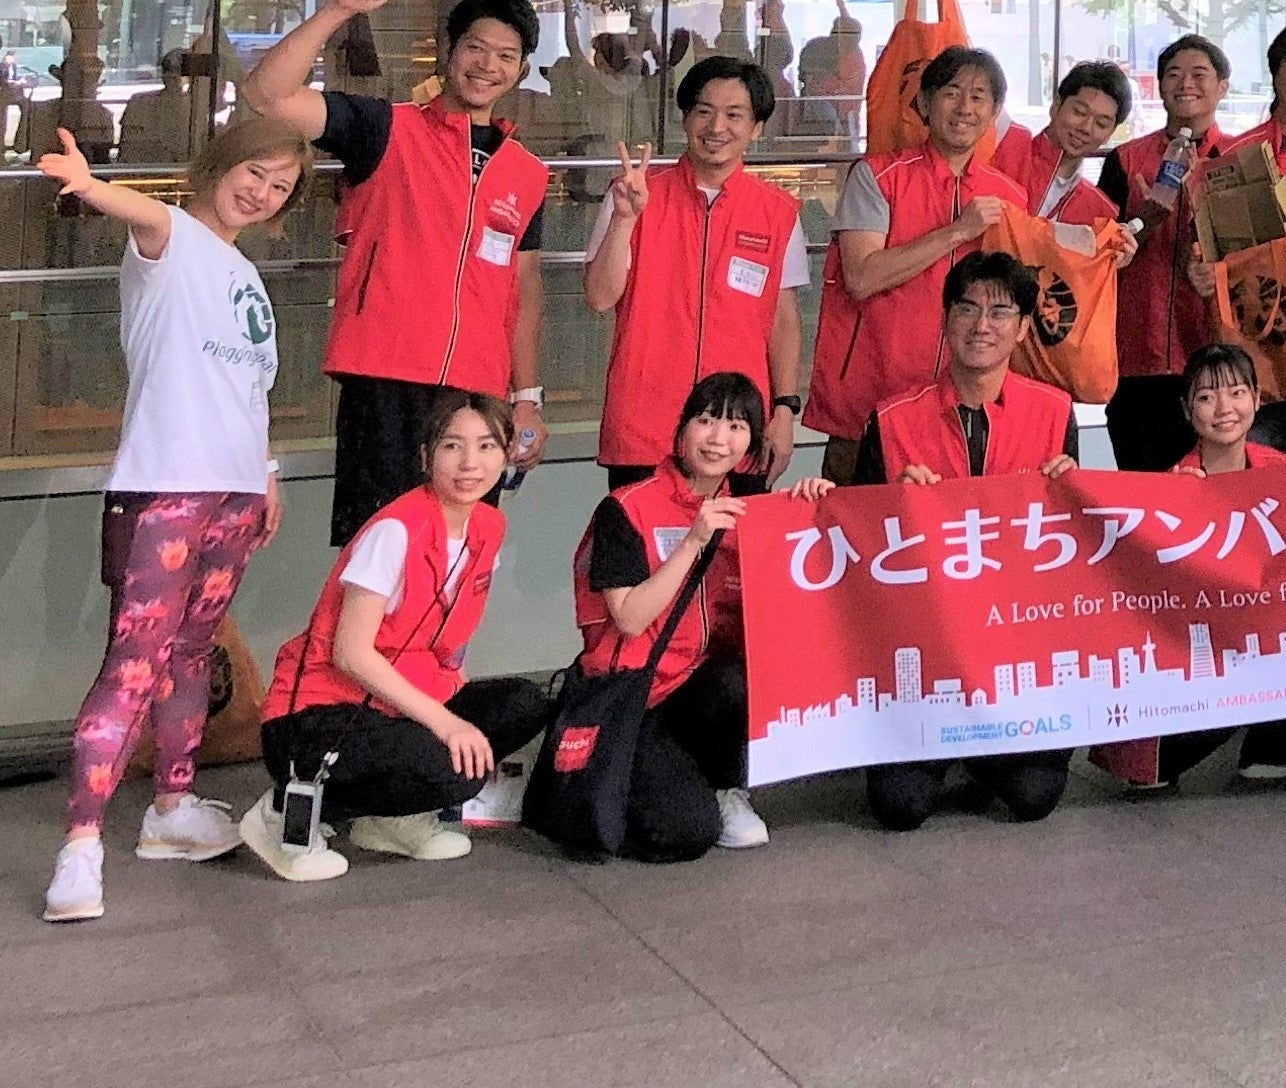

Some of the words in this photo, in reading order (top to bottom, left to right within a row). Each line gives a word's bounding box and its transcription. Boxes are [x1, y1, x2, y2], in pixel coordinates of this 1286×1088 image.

[986, 604, 1004, 626] A
[1011, 600, 1065, 624] Love
[1073, 594, 1105, 616] for
[1111, 589, 1187, 614] People.
[1195, 589, 1211, 609] A
[1219, 589, 1271, 609] Love
[1138, 698, 1209, 718] Hitomachi
[1005, 714, 1072, 738] GOALS
